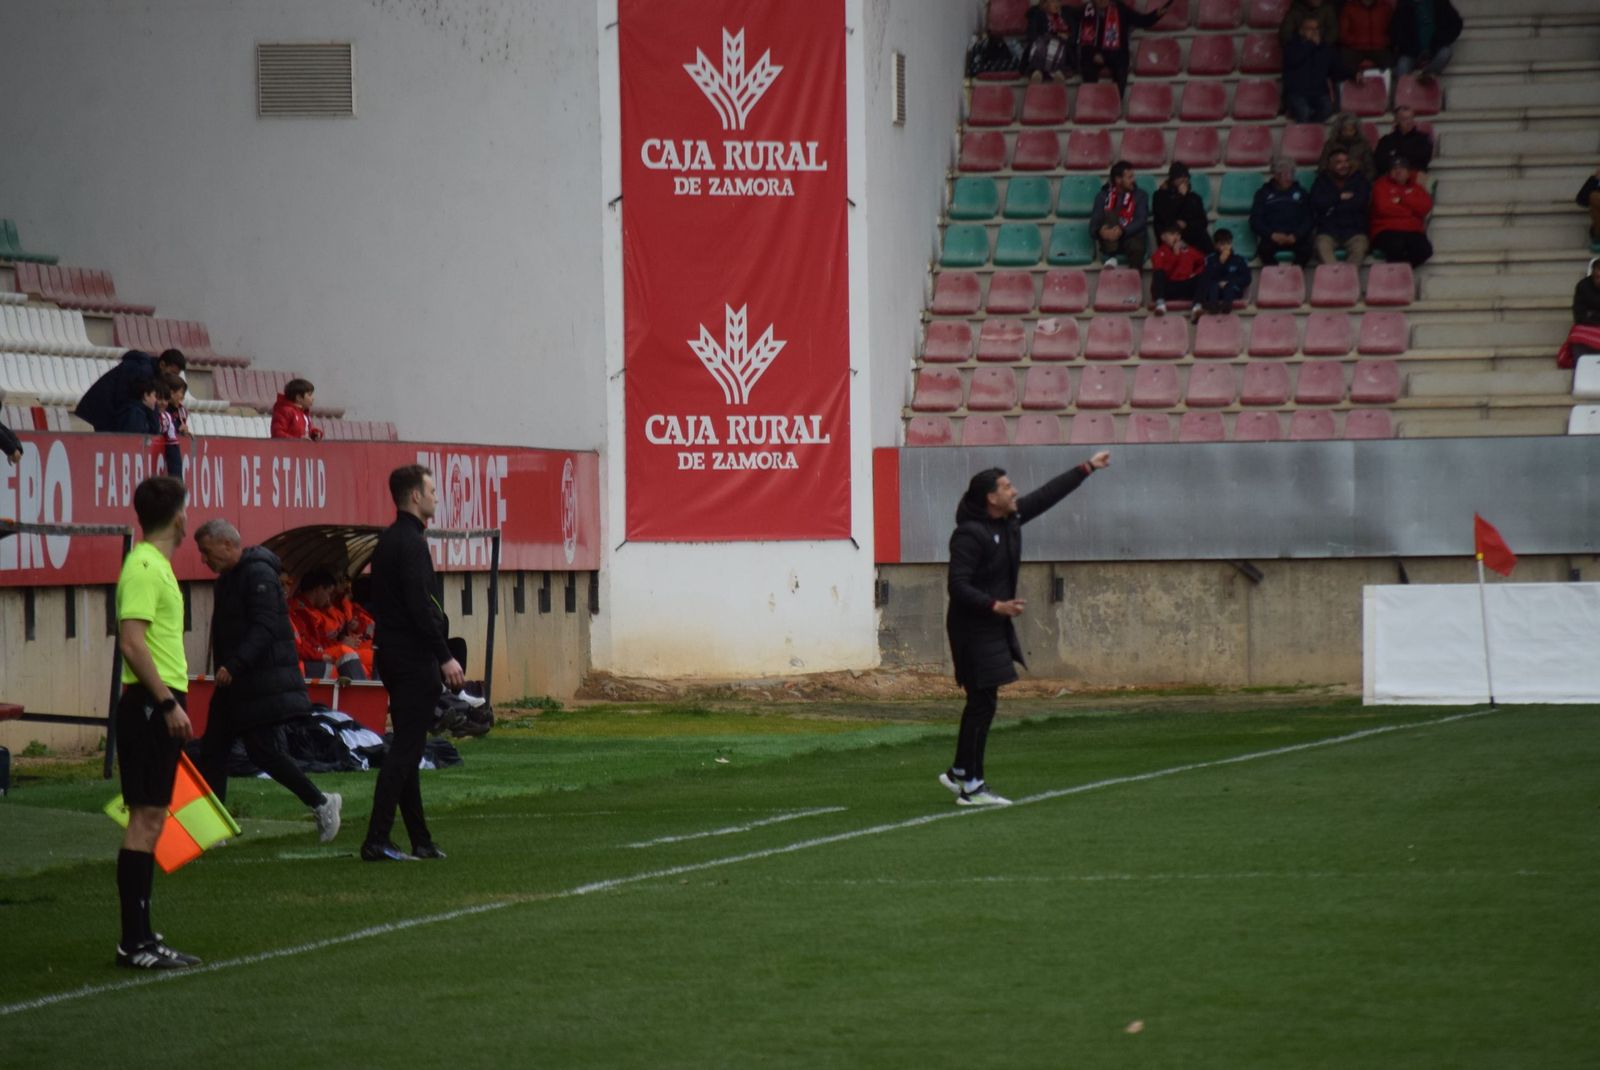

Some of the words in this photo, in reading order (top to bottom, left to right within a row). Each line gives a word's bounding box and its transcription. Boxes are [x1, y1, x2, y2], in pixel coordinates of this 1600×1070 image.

[641, 138, 716, 172] CAJA
[723, 141, 827, 171] RURAL
[674, 177, 701, 195] DE
[709, 177, 795, 196] ZAMORA
[645, 414, 719, 447] CAJA
[726, 415, 831, 445] RURAL
[95, 440, 224, 508] FABRCIÓN
[241, 455, 261, 507] DE
[272, 456, 326, 508] STAND
[678, 452, 705, 470] DE
[712, 452, 799, 470] ZAMORA
